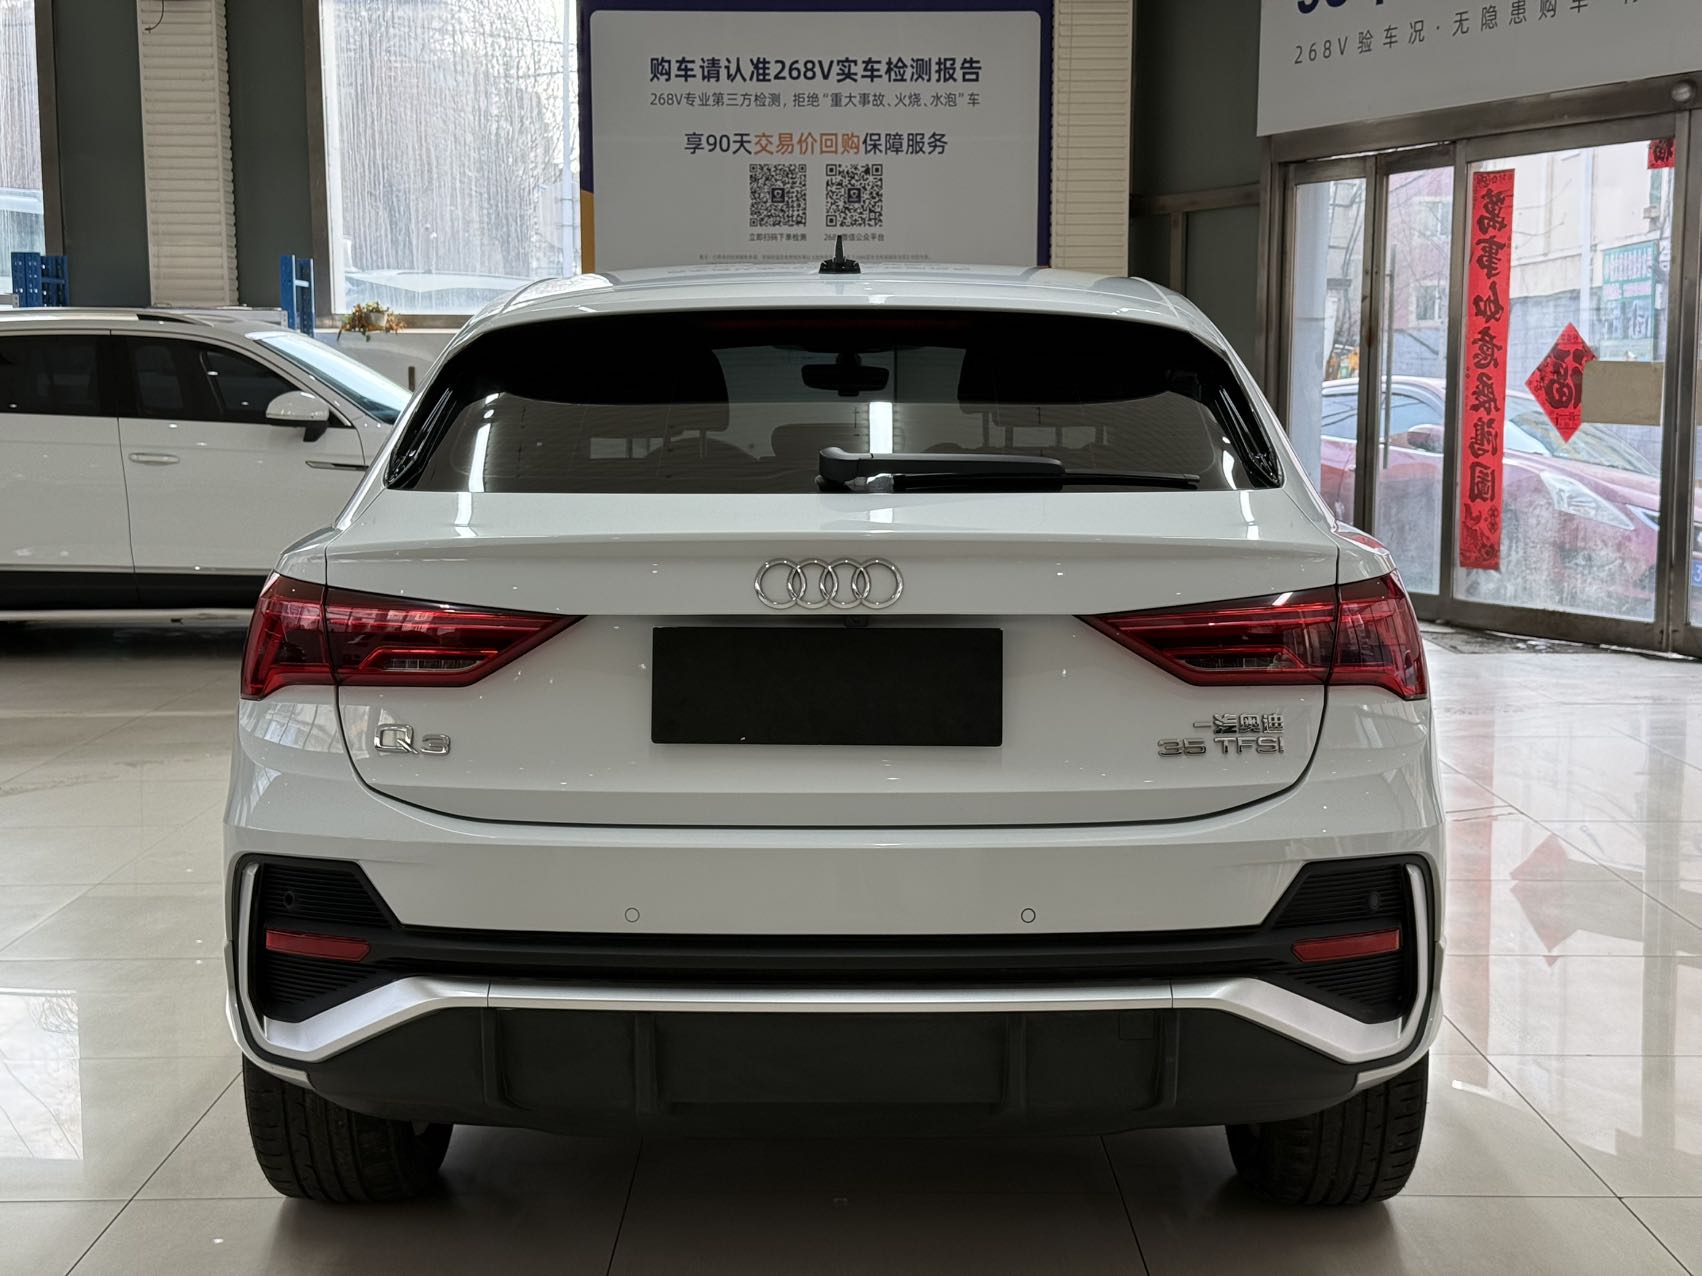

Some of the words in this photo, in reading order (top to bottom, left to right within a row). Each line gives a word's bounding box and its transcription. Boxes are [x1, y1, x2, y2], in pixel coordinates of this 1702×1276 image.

[650, 56, 982, 83] 购车请认准268V实车检测报告
[684, 131, 948, 155] 享90天交易价回购保障服务
[824, 233, 884, 241] 268微信公众平台
[1193, 713, 1285, 734] 一汽奥迪
[374, 723, 451, 756] Q3
[1158, 738, 1207, 757] 35
[1214, 736, 1285, 755] TFSI
